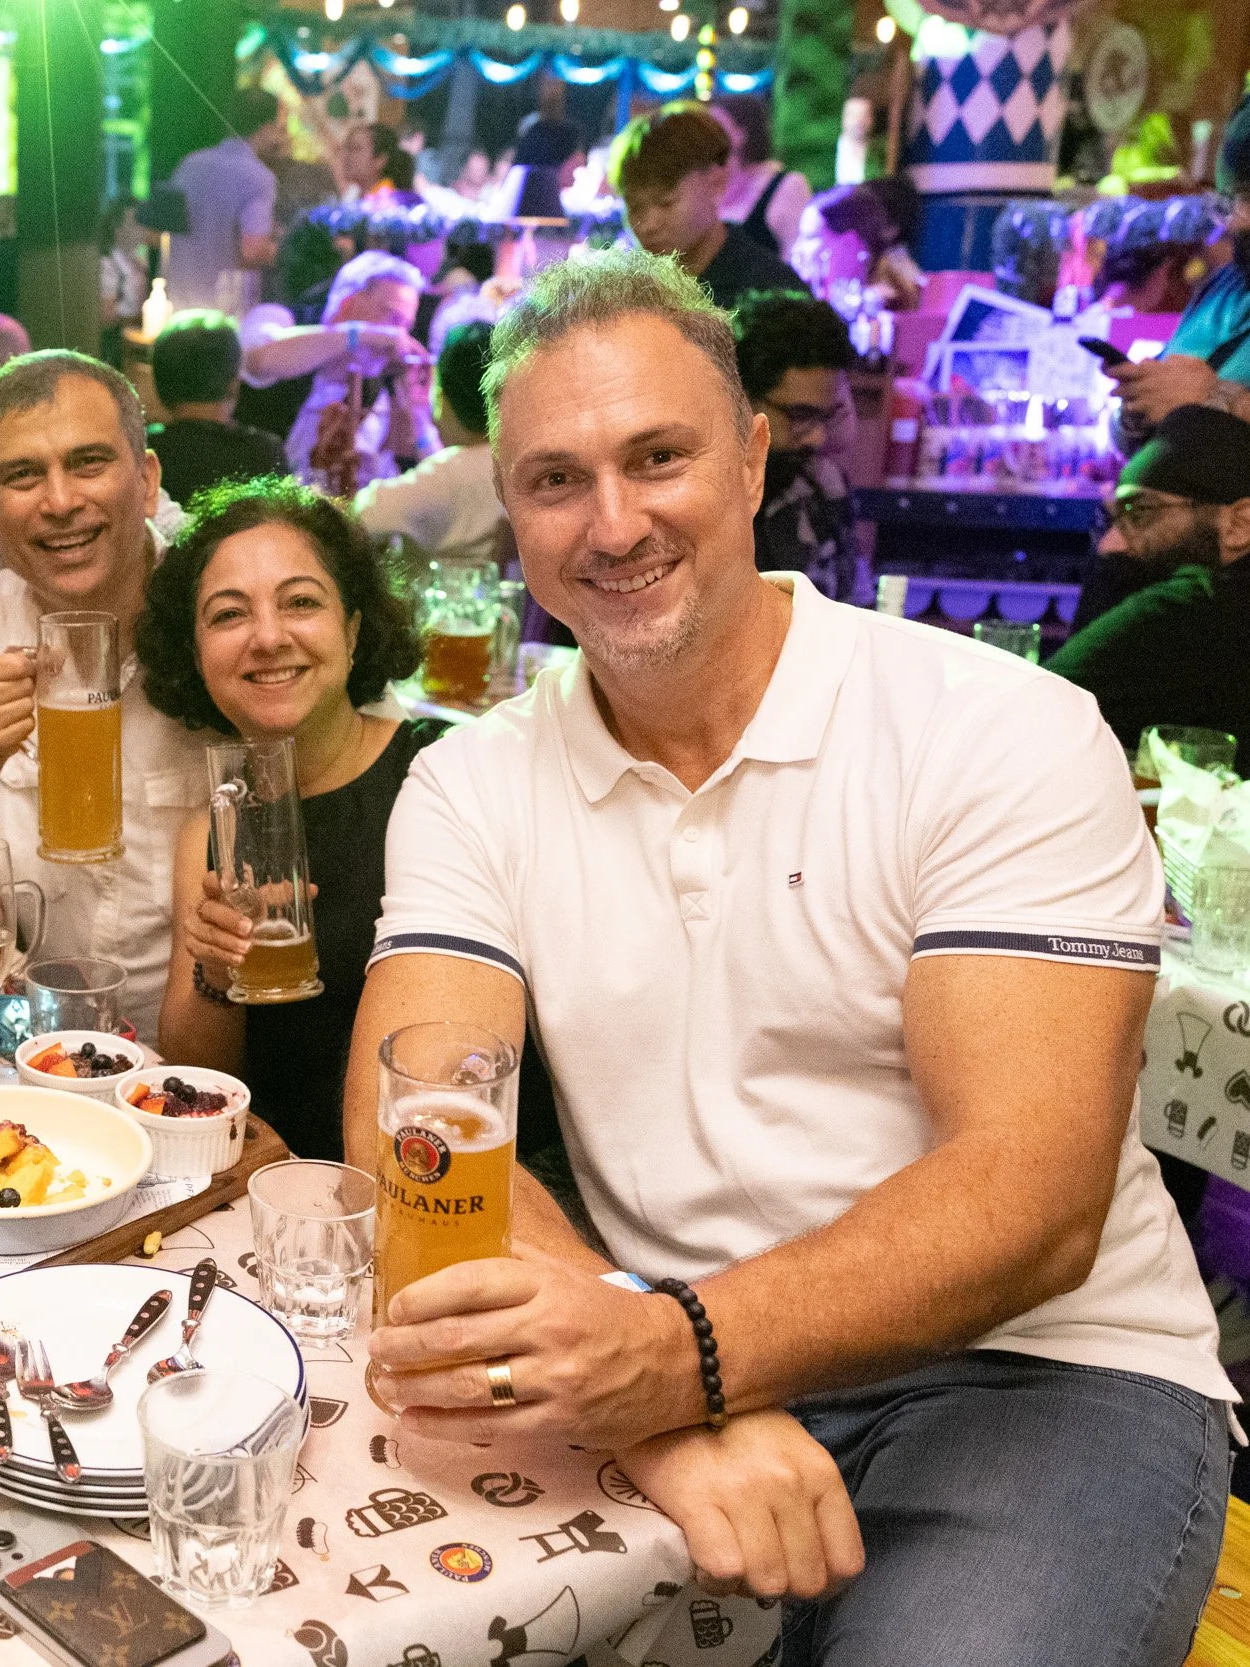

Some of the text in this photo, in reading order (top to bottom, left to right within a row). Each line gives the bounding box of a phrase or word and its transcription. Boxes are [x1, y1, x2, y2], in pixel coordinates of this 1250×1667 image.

[1047, 937, 1144, 960] Tommy Jeans
[395, 1128, 447, 1153] PAULANER
